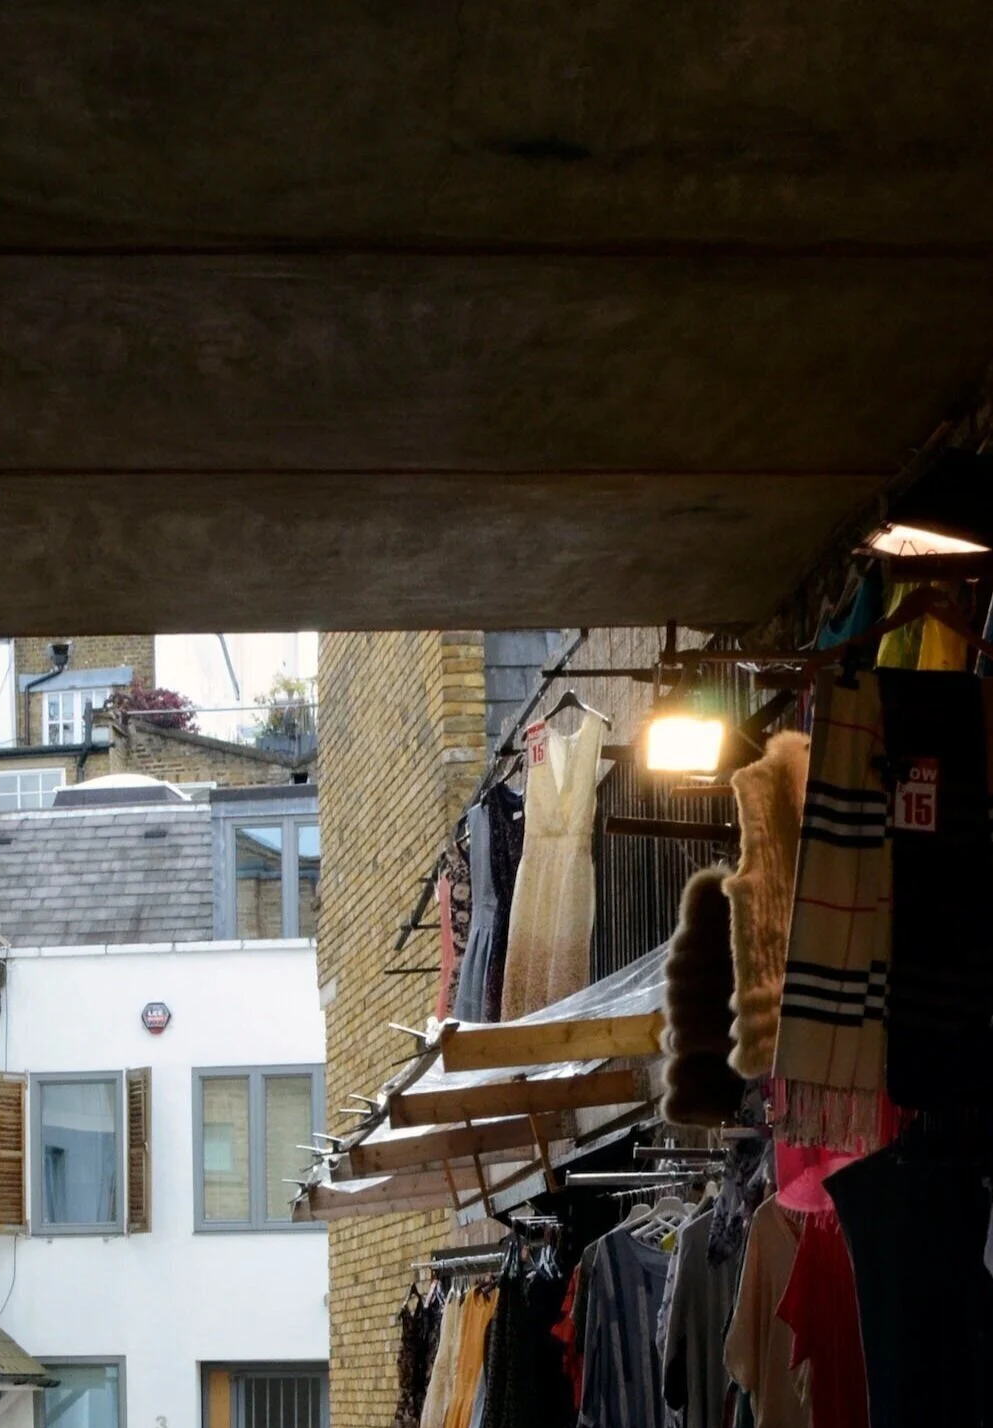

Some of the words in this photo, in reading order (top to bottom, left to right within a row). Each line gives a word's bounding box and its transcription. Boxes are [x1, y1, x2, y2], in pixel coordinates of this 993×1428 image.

[532, 743, 544, 763] 15
[906, 766, 938, 781] OW
[902, 792, 932, 825] 15
